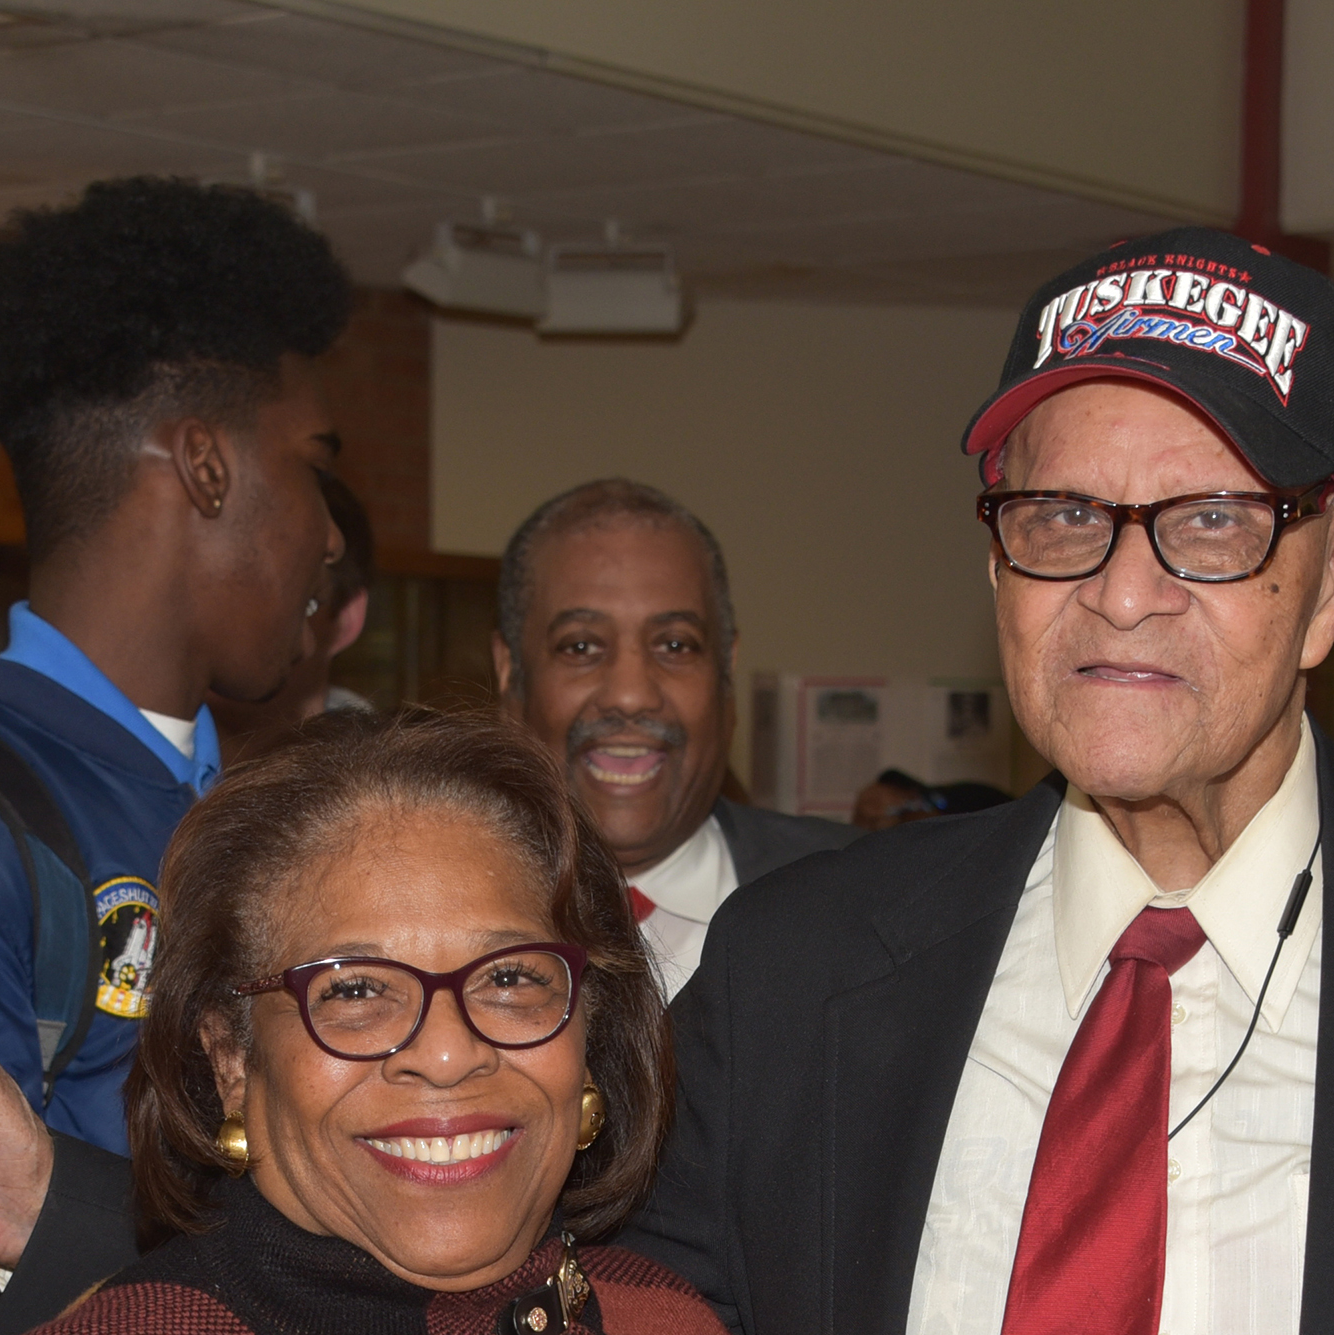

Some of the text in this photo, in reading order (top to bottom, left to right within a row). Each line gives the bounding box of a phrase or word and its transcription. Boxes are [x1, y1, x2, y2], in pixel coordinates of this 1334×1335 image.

[1164, 254, 1238, 279] KNIGHTS
[1033, 270, 1308, 396] TUSKEGEE
[1059, 308, 1266, 374] Airmen
